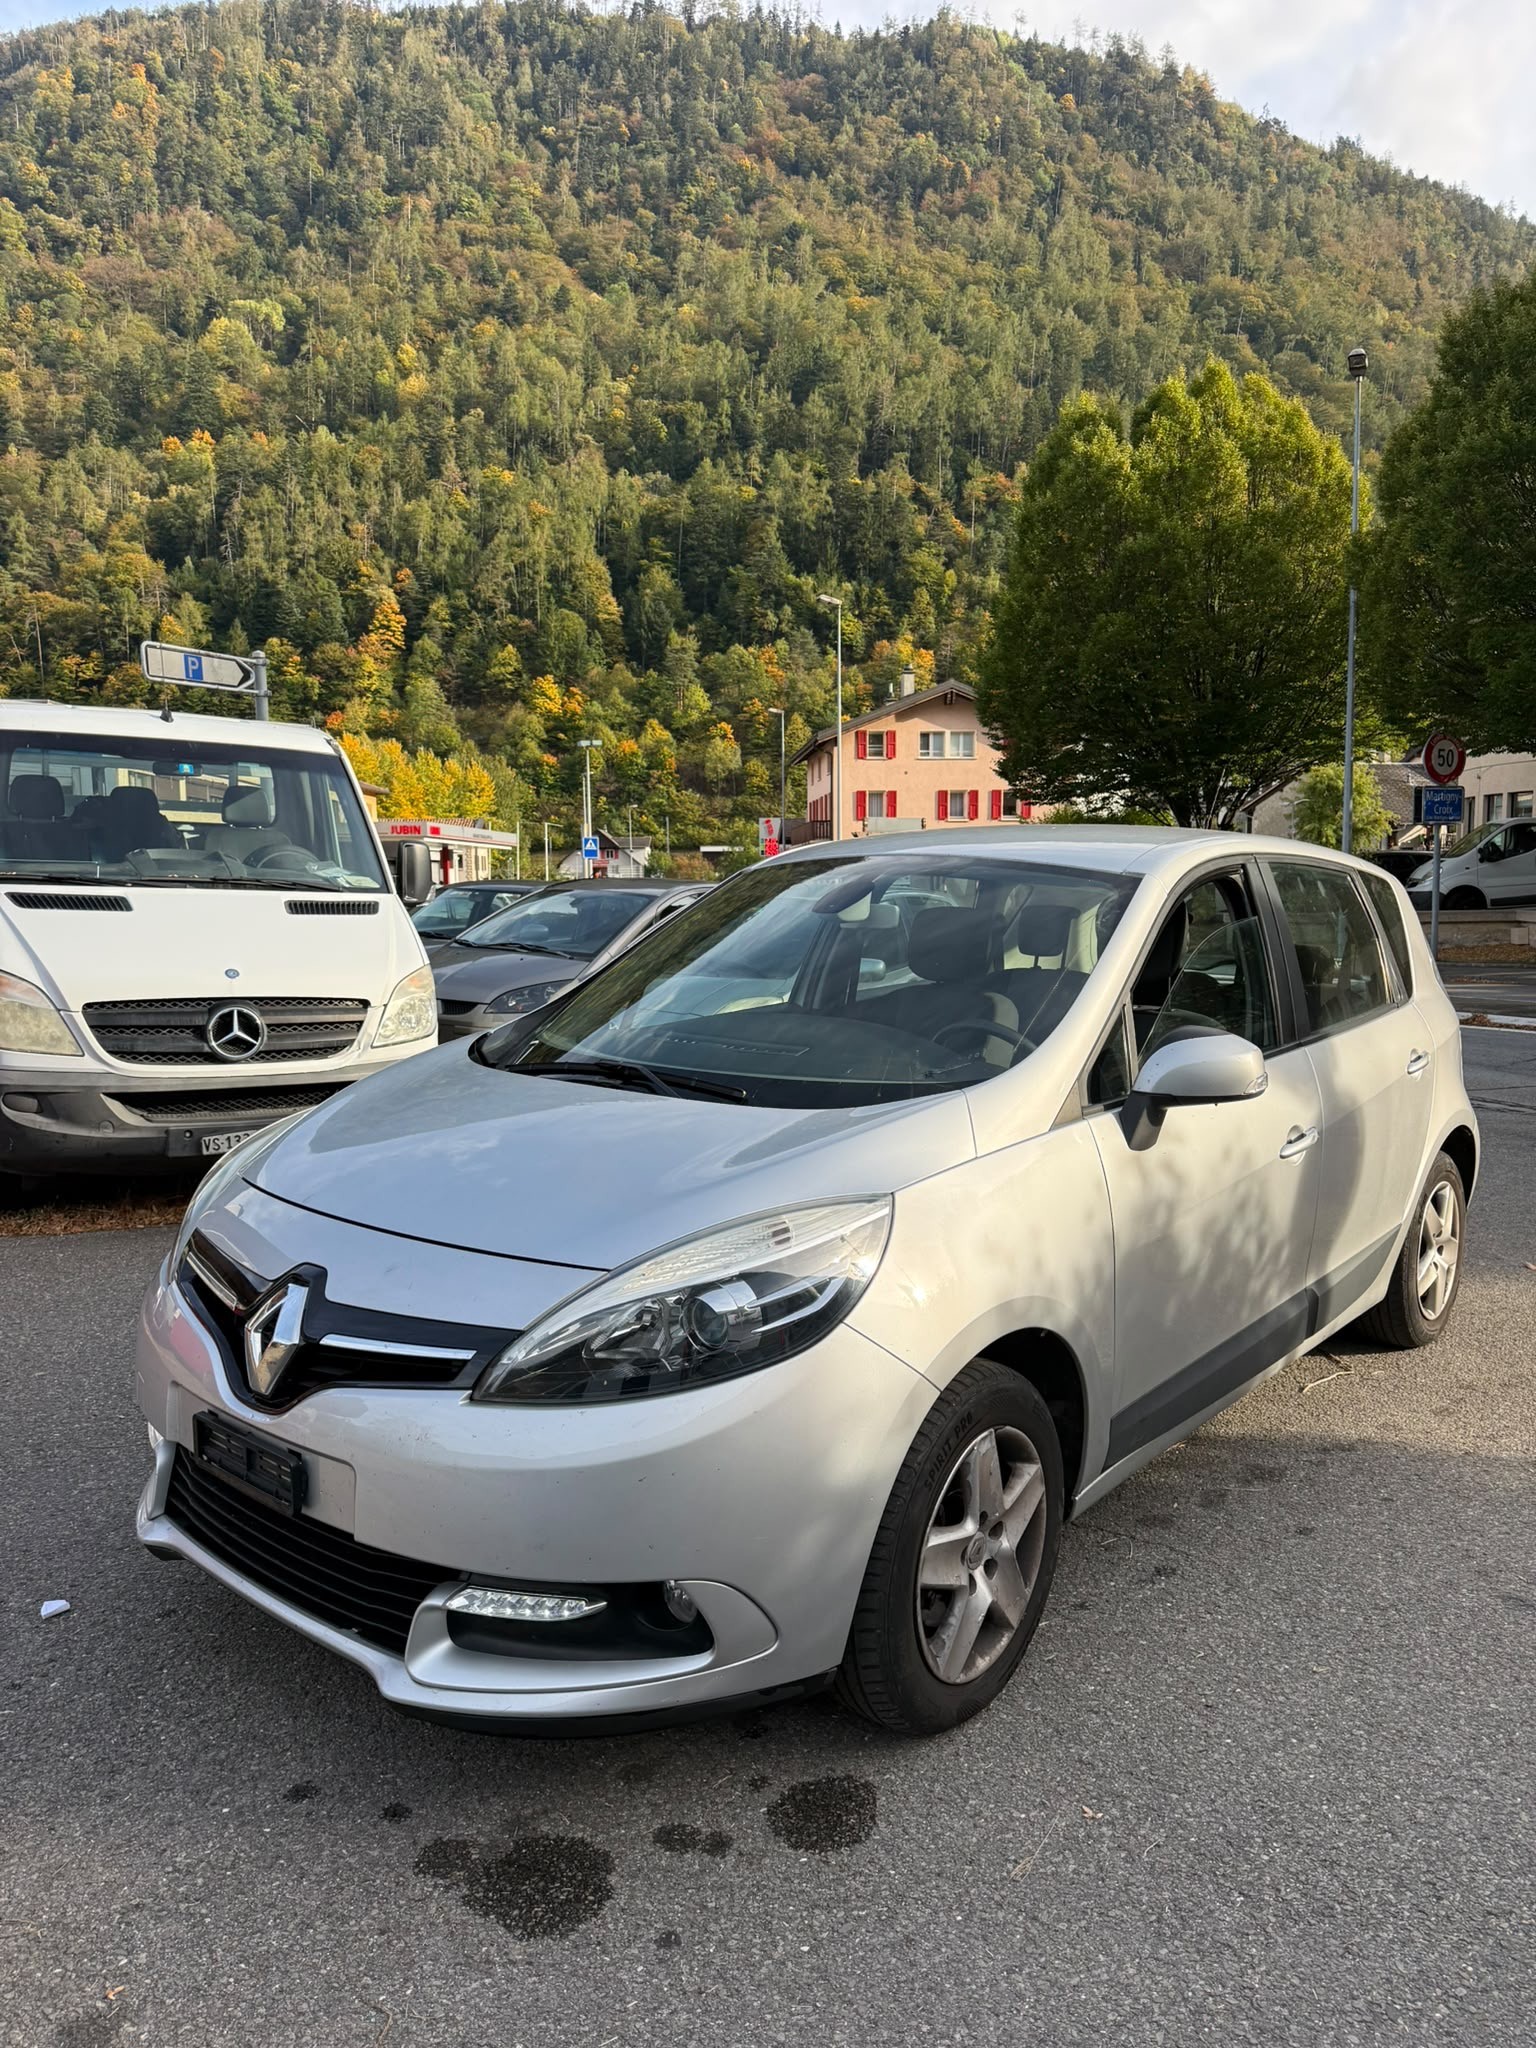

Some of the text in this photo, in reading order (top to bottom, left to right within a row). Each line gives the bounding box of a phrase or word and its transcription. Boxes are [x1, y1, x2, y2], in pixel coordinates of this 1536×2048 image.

[187, 656, 199, 678] P
[1437, 748, 1454, 768] 50
[1434, 804, 1453, 815] Croix
